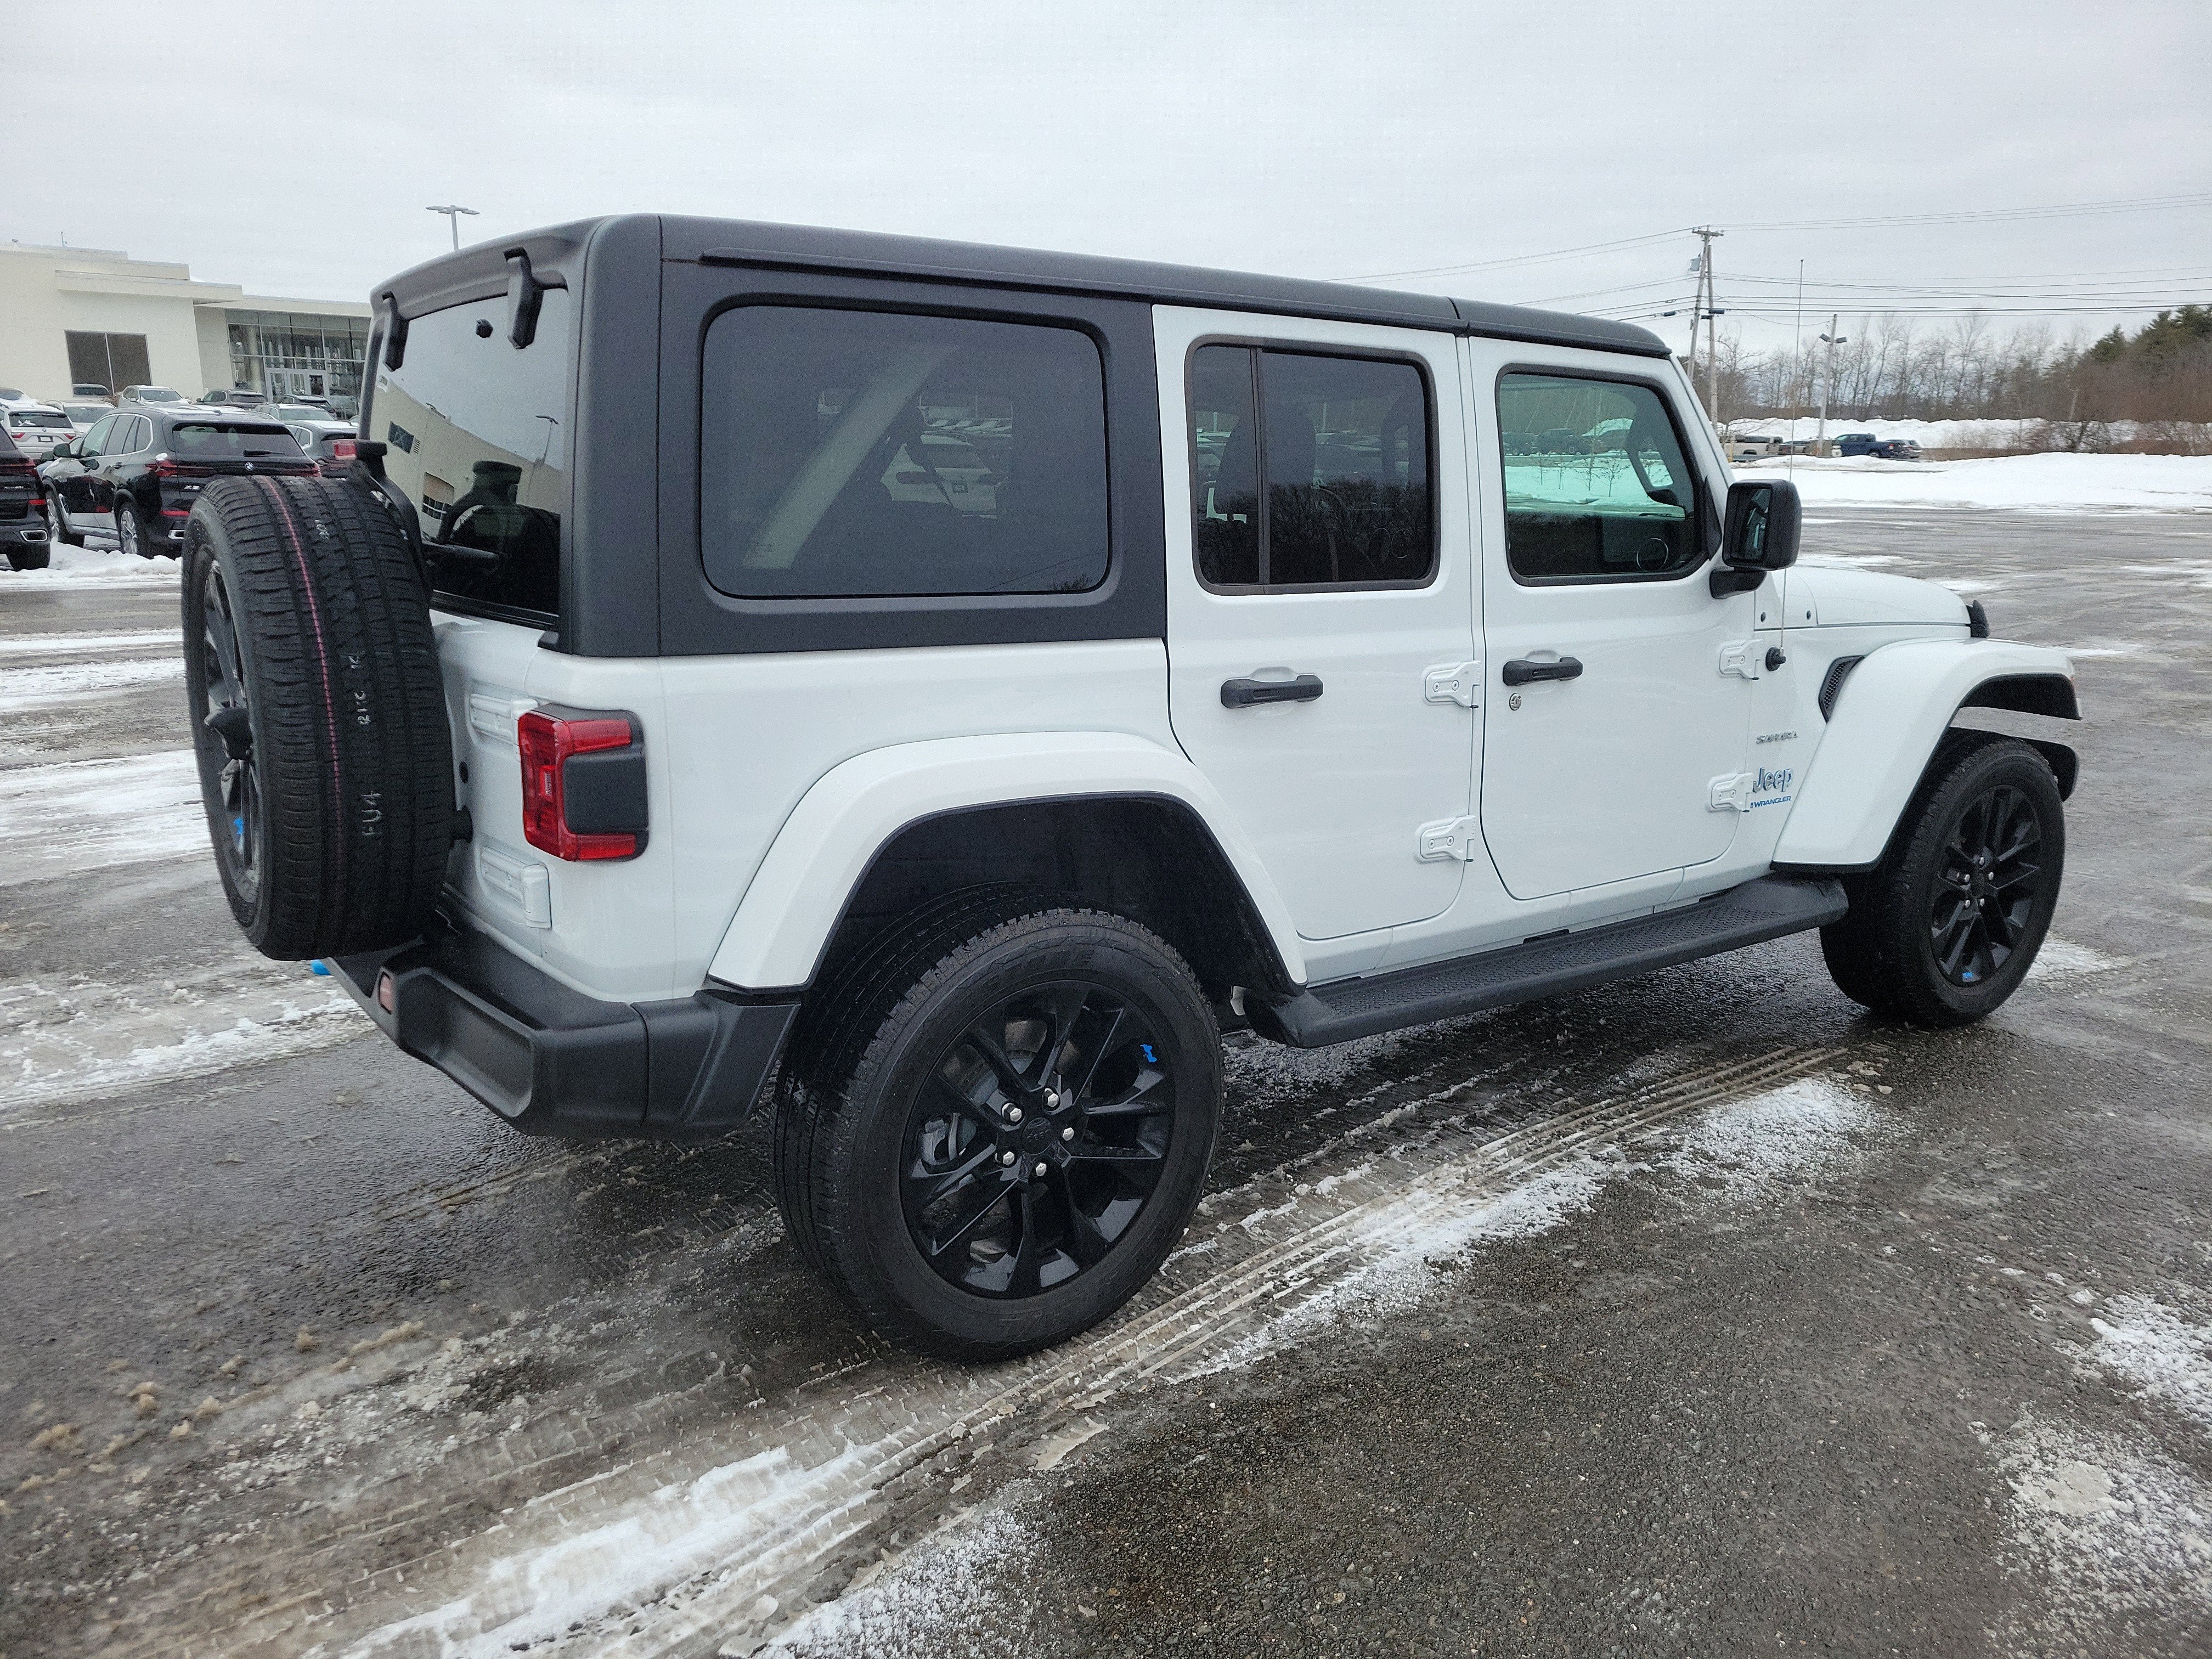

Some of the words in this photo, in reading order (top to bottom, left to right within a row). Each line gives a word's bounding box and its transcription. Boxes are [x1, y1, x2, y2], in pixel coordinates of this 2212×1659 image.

[1756, 731, 1798, 744] SAHARA
[1752, 768, 1793, 793] Jeep
[1753, 795, 1791, 808] WRANGLER
